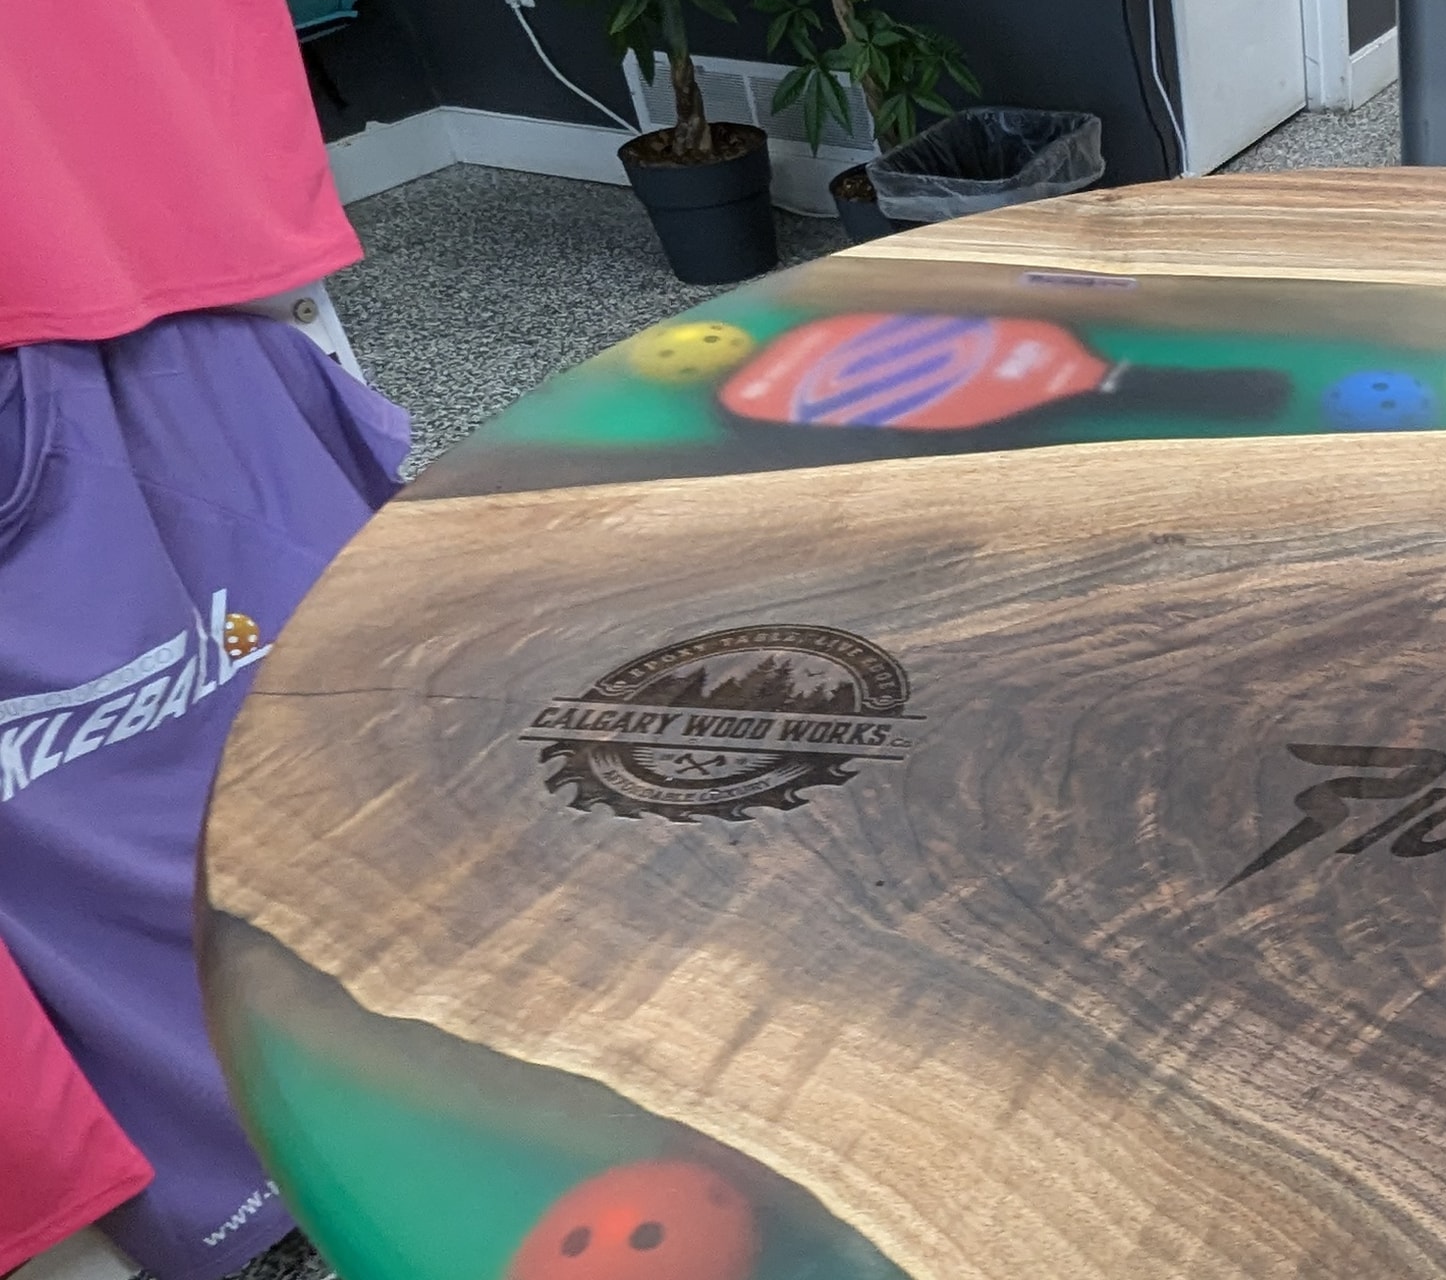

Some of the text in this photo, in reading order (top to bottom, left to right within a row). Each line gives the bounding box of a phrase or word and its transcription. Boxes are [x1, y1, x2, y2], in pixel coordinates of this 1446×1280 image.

[529, 706, 684, 735] CALGARY
[682, 714, 774, 740] WOOD
[777, 720, 893, 747] WORKS
